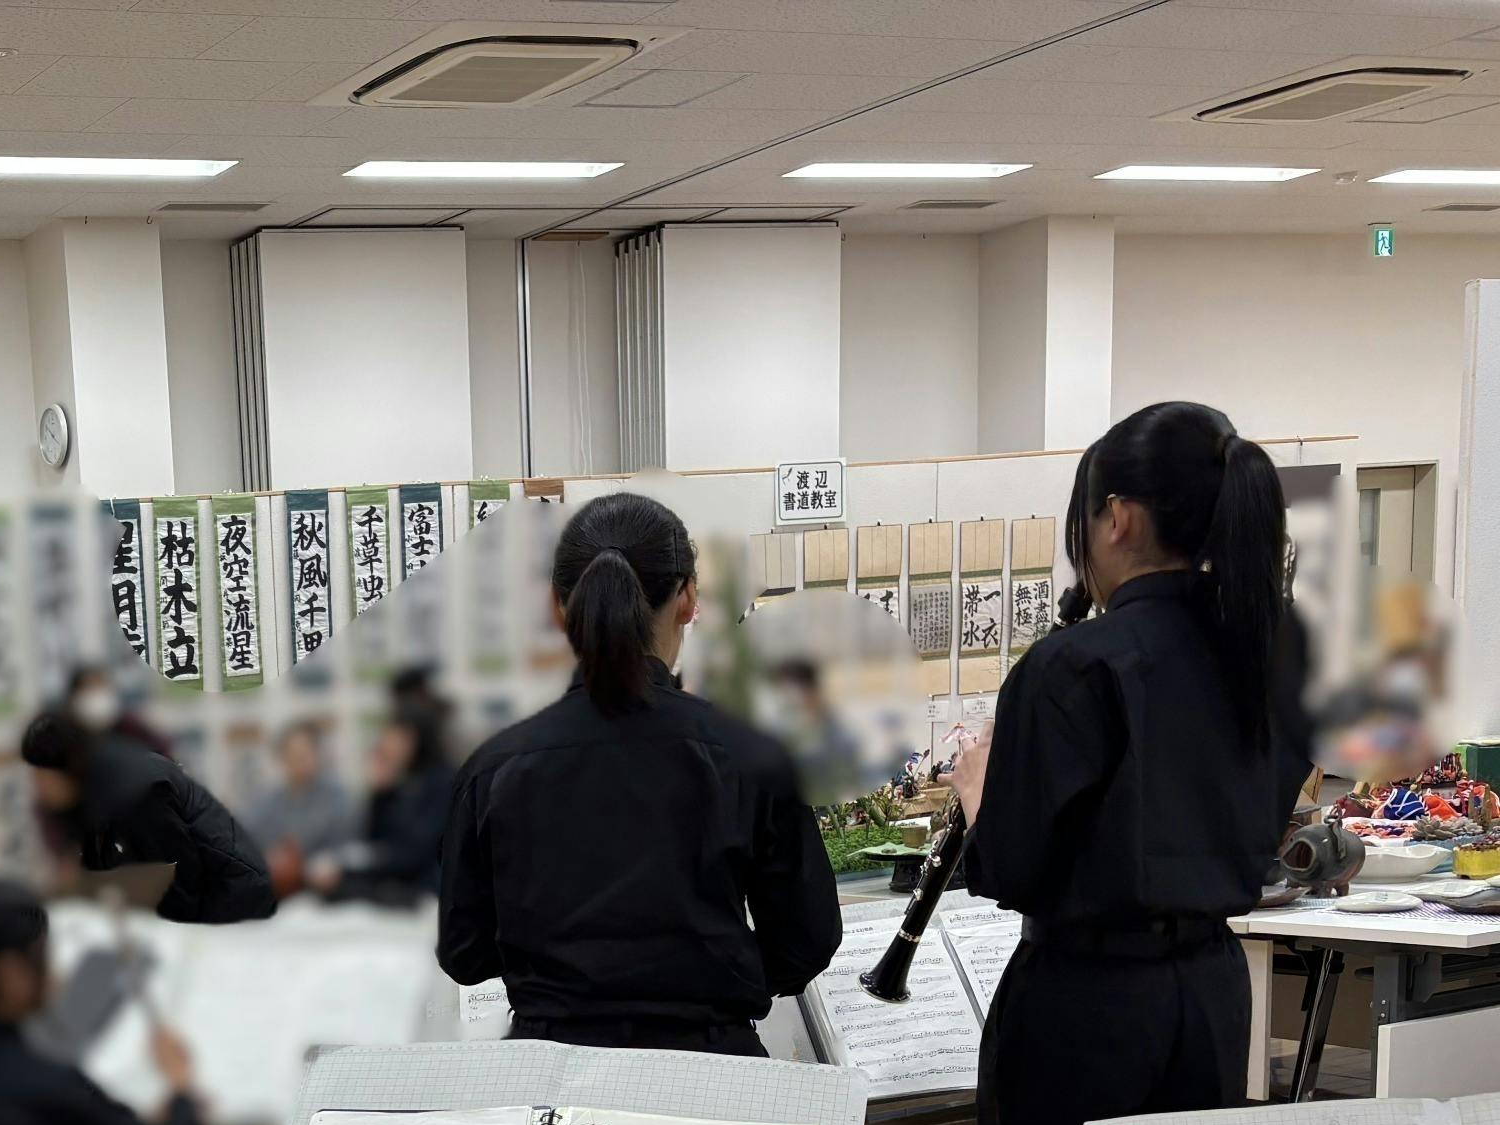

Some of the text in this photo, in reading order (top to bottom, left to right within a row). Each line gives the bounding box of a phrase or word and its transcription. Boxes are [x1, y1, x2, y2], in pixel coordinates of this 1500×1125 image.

[408, 503, 435, 568] 富士
[782, 490, 837, 511] 書道教室
[159, 520, 199, 679] 枯木立
[220, 514, 255, 671] 夜空流星
